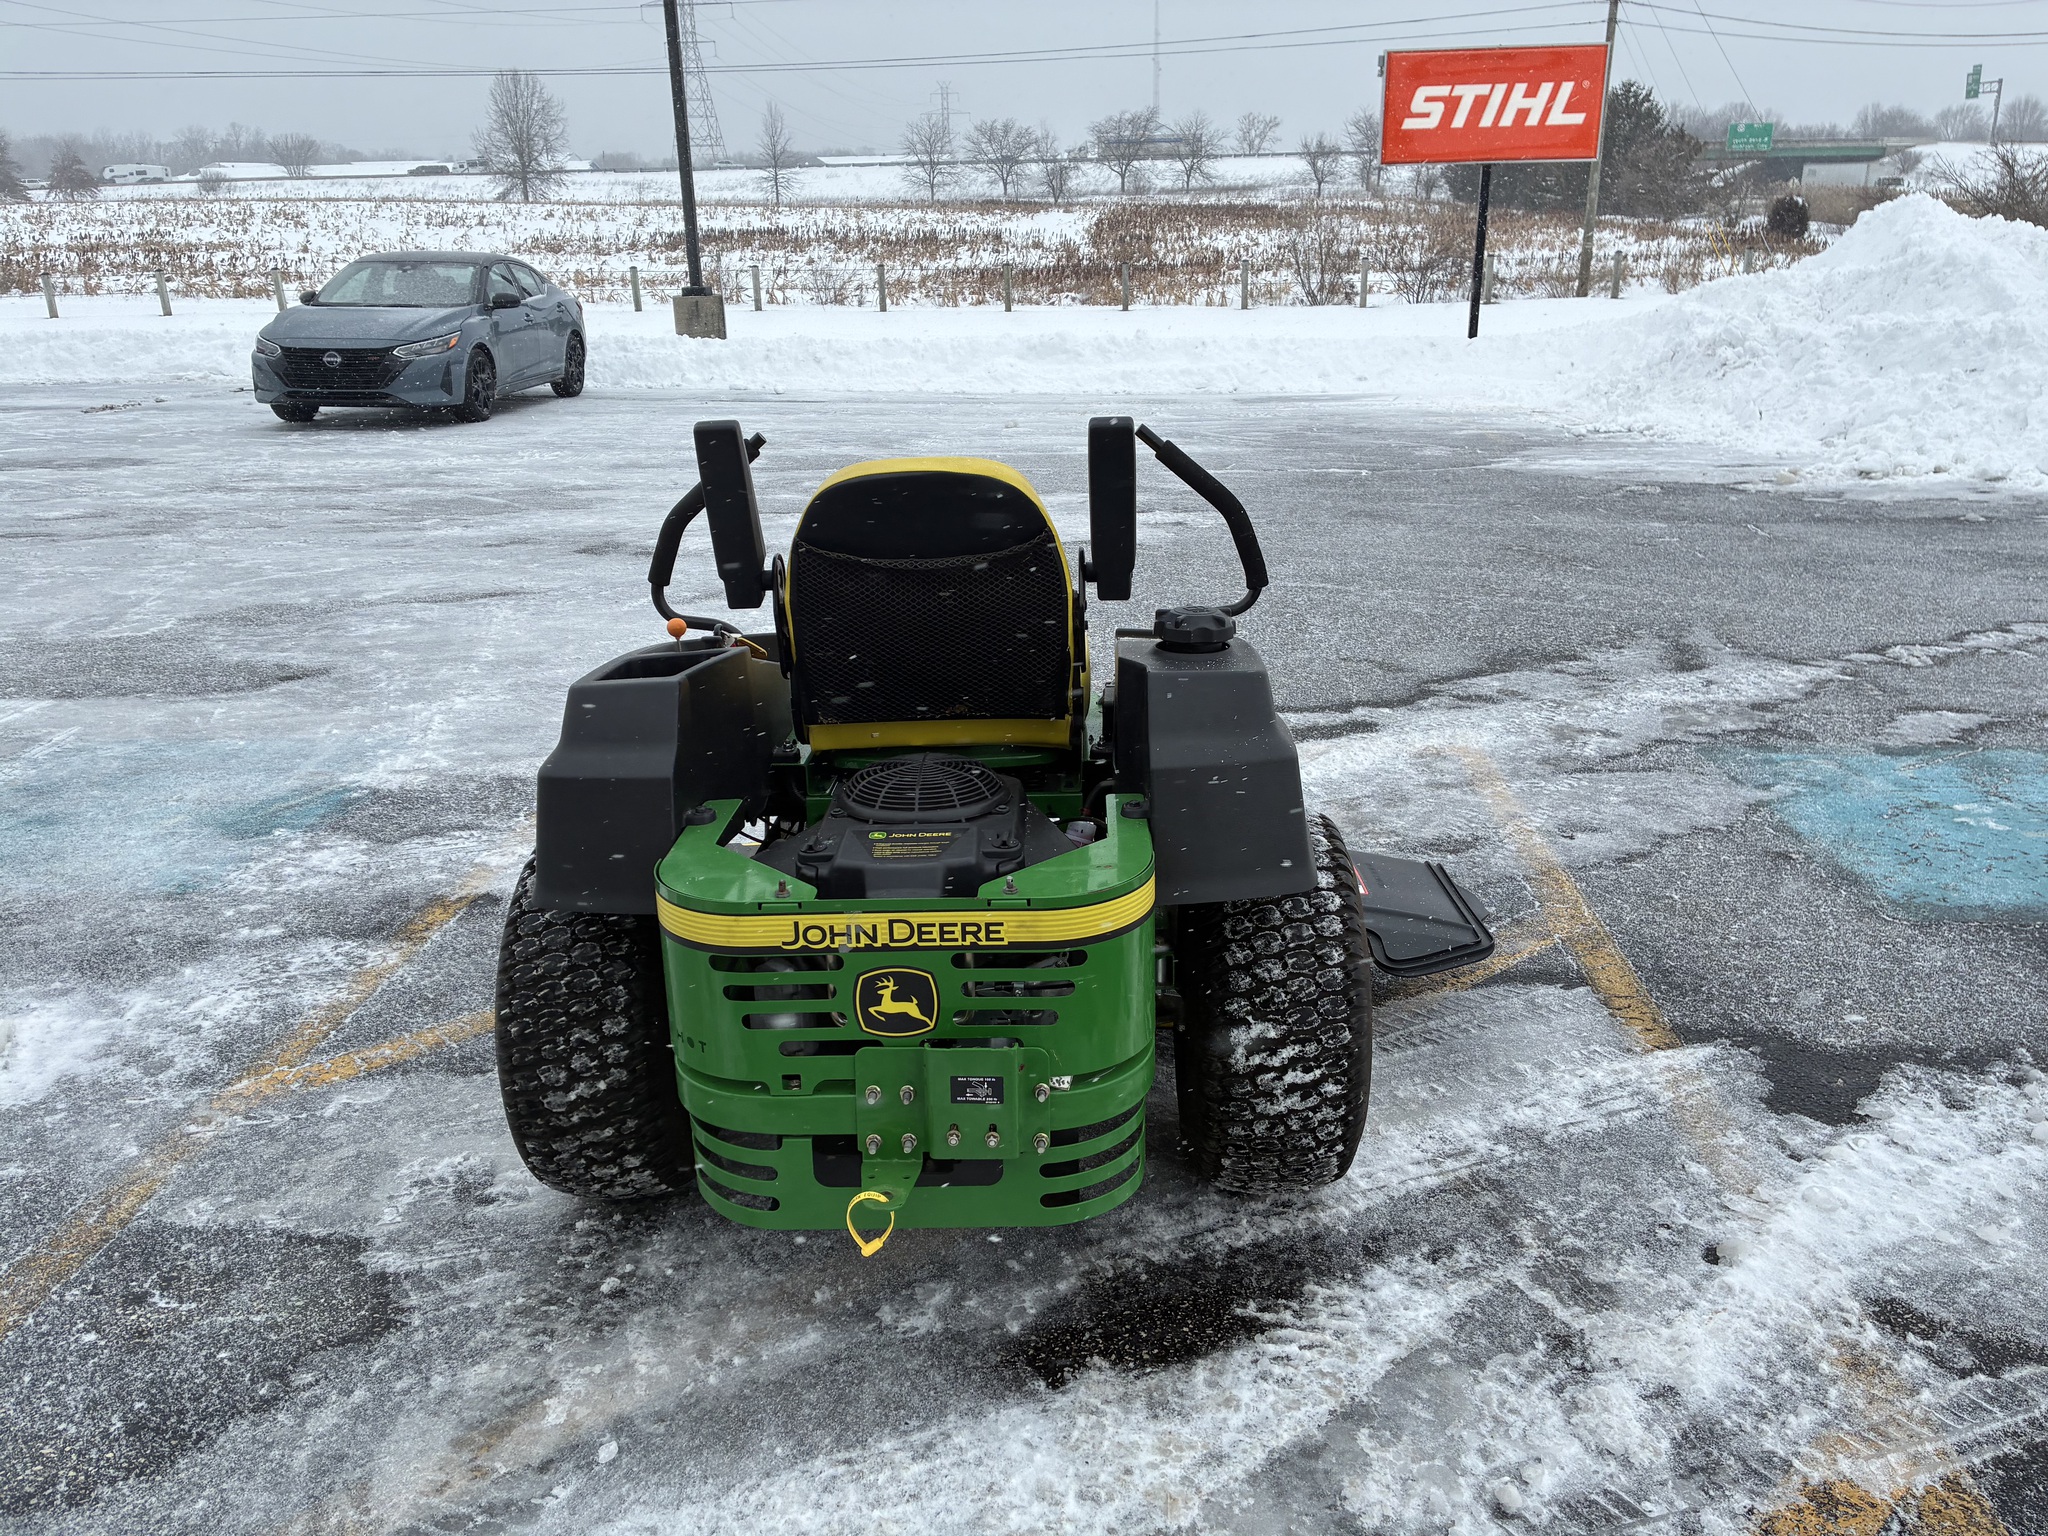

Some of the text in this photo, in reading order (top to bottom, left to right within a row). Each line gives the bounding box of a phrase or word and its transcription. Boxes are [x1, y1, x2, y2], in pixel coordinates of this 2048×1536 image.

[1401, 81, 1587, 130] STIHL
[781, 918, 1005, 946] JOHN DEERE
